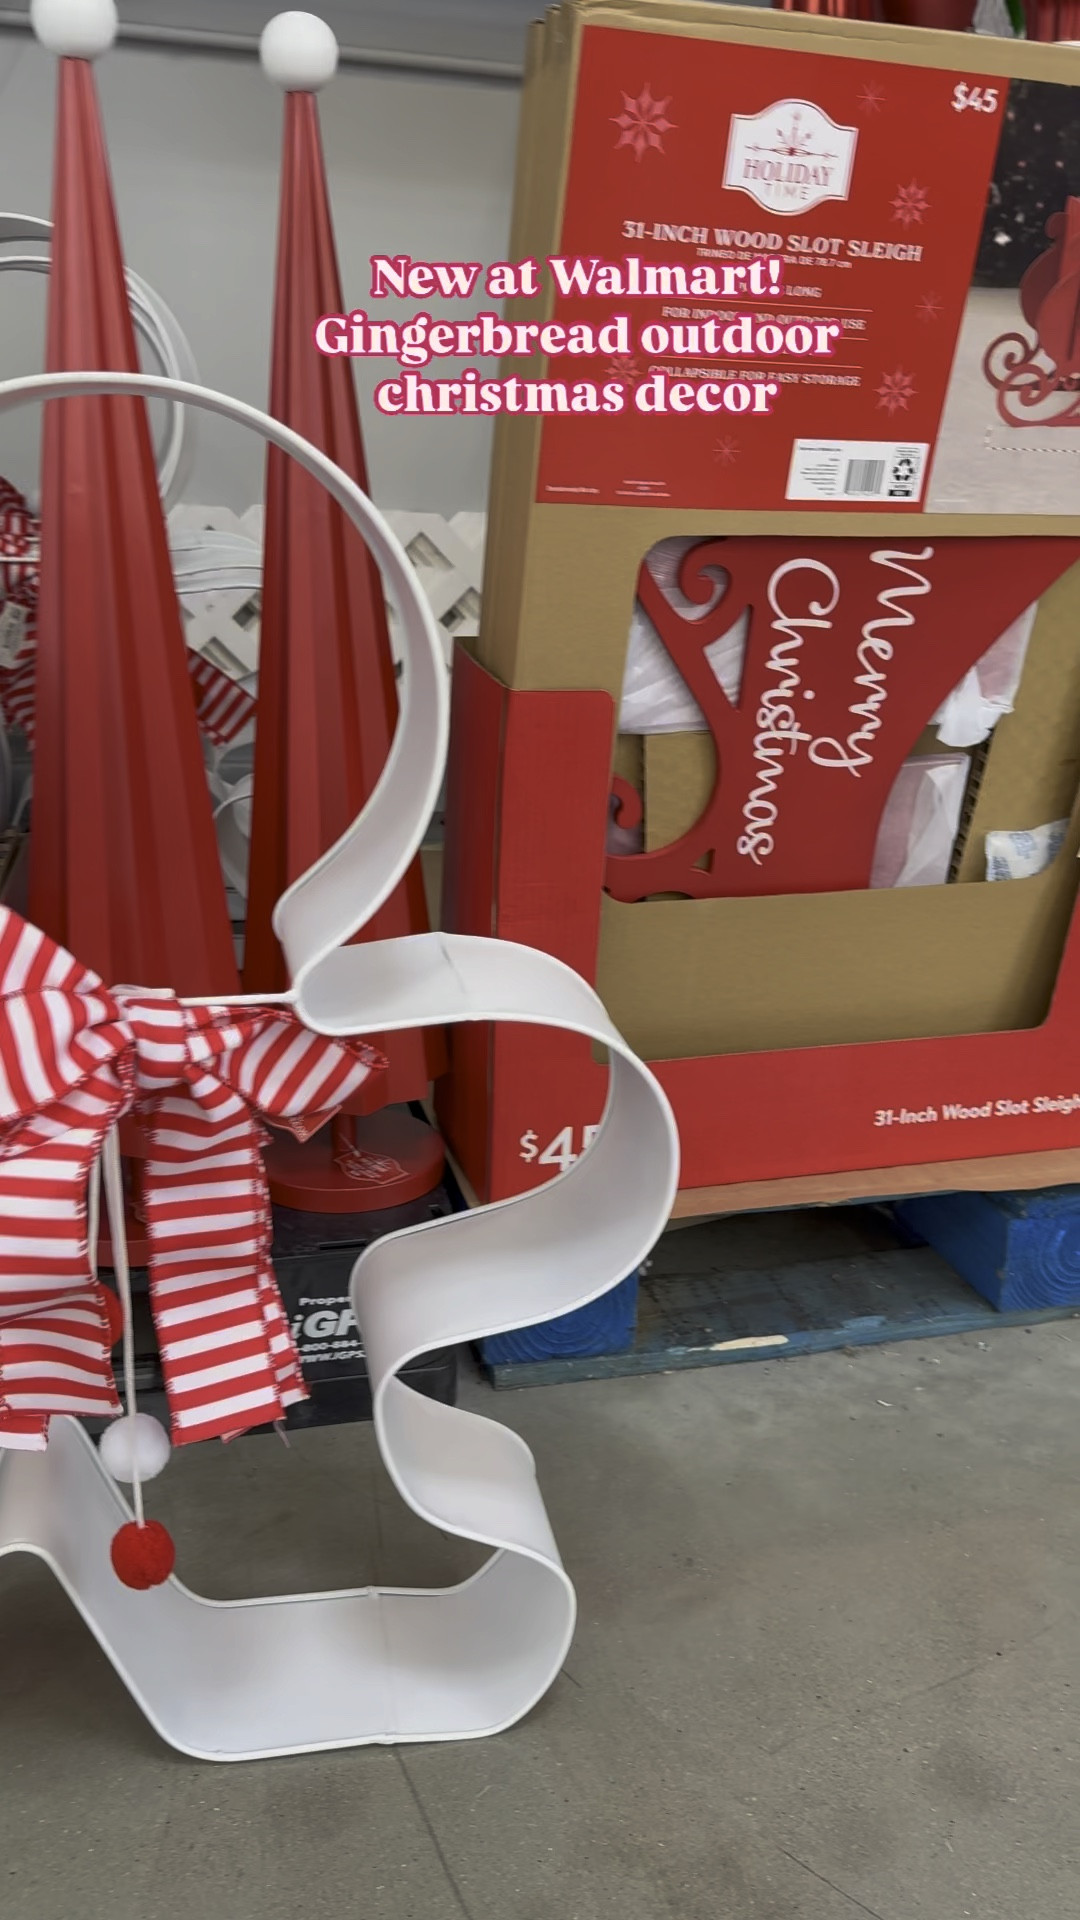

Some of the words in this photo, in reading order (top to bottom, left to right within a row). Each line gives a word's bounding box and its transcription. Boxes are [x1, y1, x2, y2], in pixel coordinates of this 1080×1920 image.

[950, 80, 1000, 113] $45
[742, 158, 835, 187] HOLIDAY
[764, 182, 810, 201] TIME
[621, 220, 709, 245] 31-INCH
[713, 228, 783, 251] WOOD
[786, 234, 845, 256] SLOT
[846, 240, 924, 262] SLEIGH
[785, 285, 823, 298] LONG
[692, 308, 738, 321] INDOO
[648, 365, 738, 380] CLLAPSIBLE
[801, 373, 862, 387] STORAGE
[808, 546, 934, 778] Merry
[736, 557, 840, 866] Christmas
[873, 1106, 938, 1127] 31-Inch
[941, 1101, 993, 1121] Wood
[994, 1099, 1030, 1117] Slot
[1031, 1093, 1080, 1115] Sleigh
